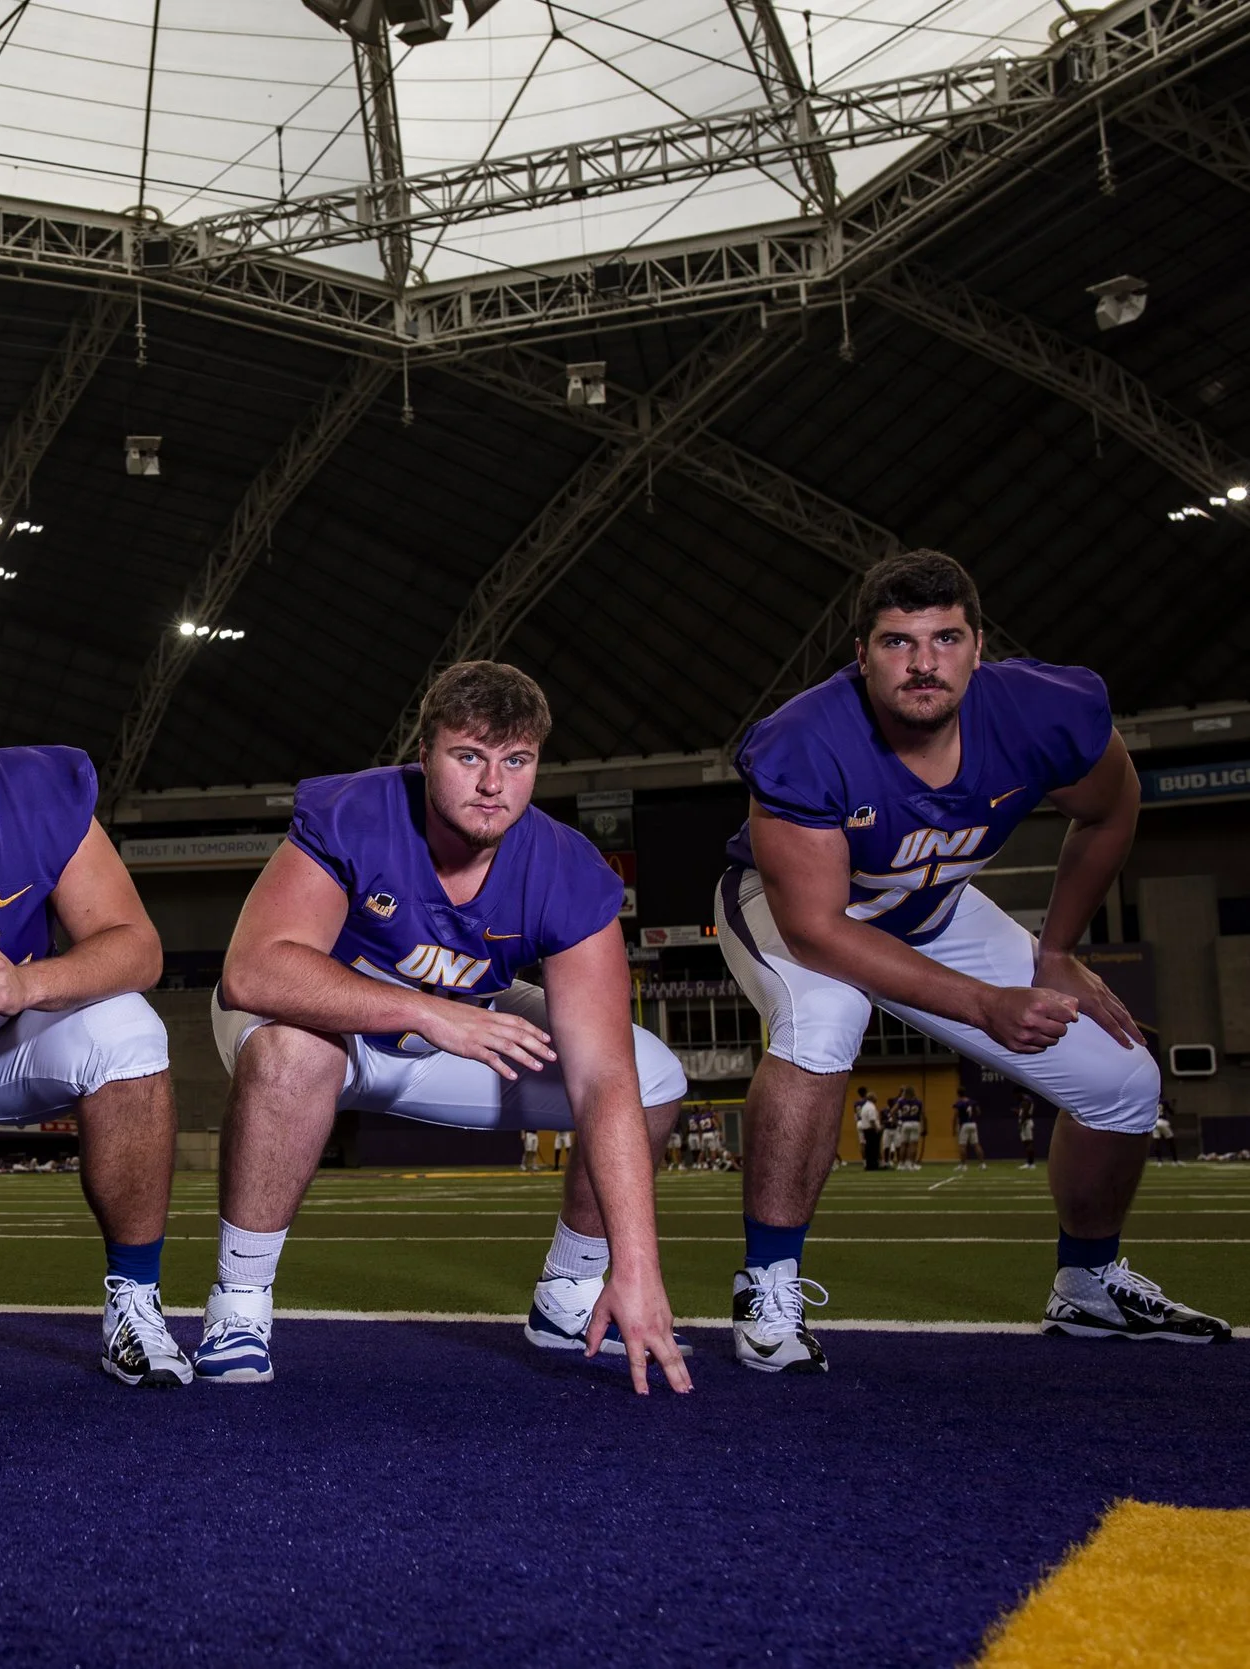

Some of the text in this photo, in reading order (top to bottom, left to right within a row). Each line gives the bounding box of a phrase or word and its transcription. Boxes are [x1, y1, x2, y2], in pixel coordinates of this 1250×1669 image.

[1159, 774, 1207, 792] BUD
[130, 840, 270, 857] TRUST IN TOMORROW.
[890, 825, 990, 869] UNI
[395, 943, 492, 988] UNI
